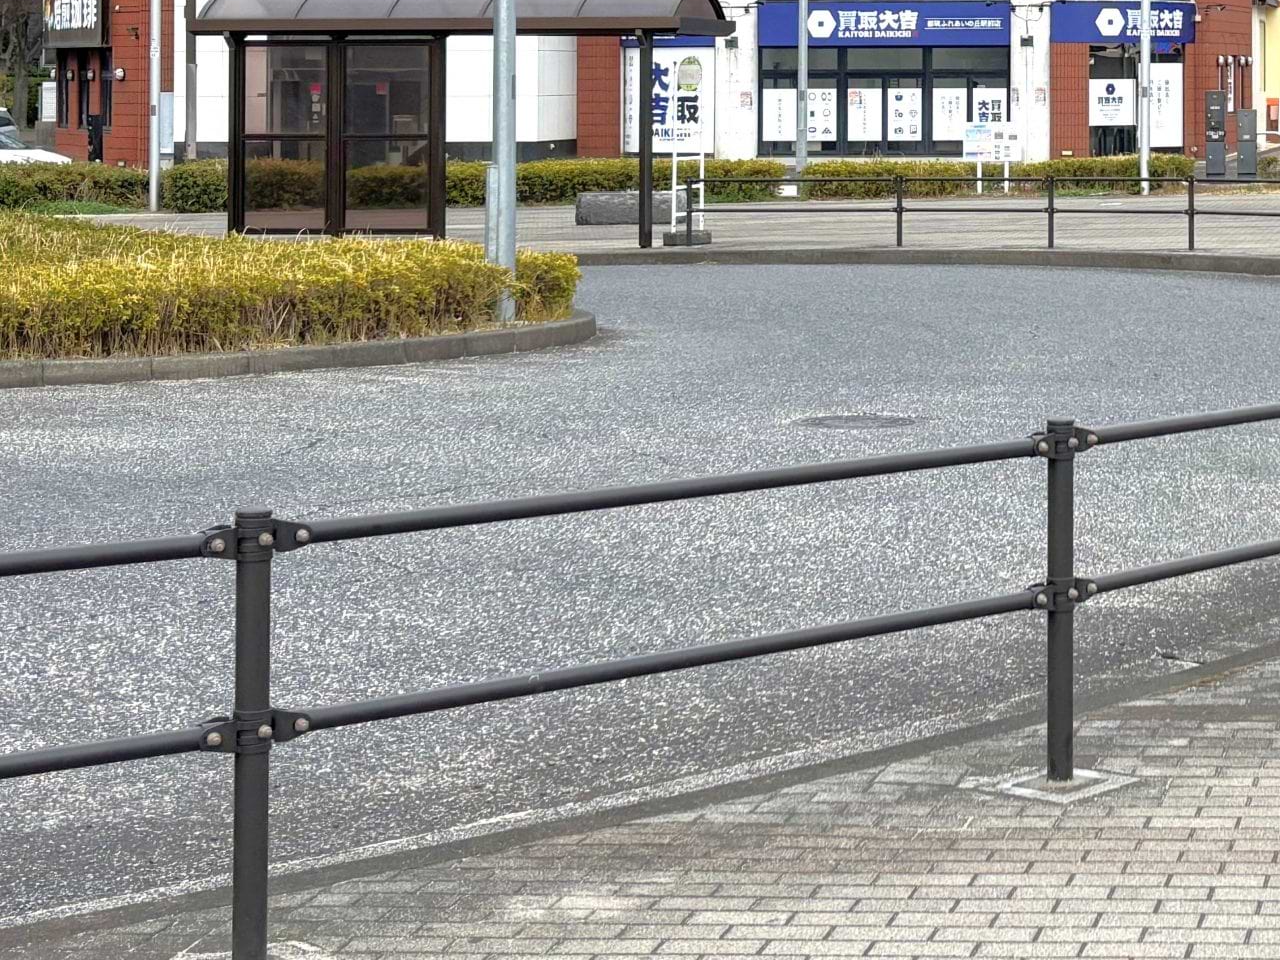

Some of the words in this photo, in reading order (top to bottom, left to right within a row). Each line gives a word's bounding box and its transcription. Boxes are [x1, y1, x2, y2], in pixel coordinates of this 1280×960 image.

[837, 9, 919, 31] 買取大吉
[838, 30, 873, 38] KAITORI
